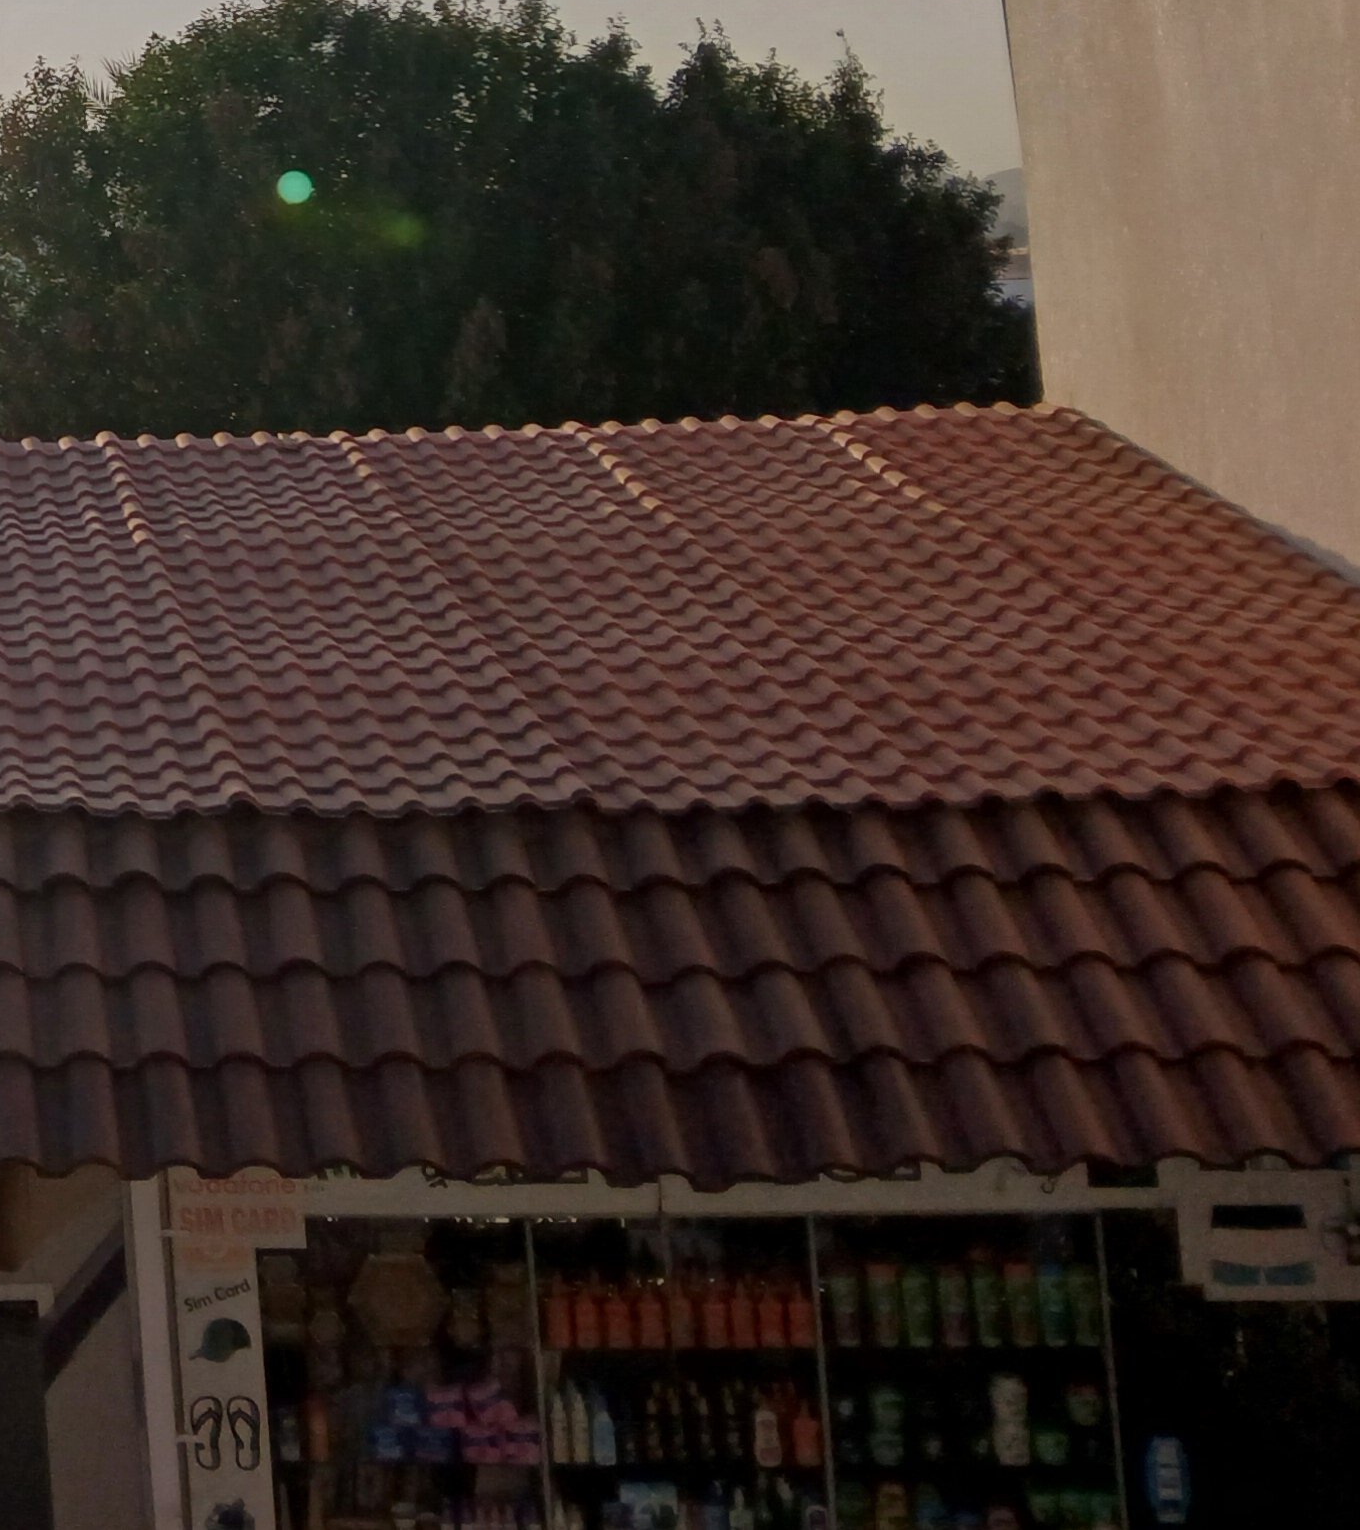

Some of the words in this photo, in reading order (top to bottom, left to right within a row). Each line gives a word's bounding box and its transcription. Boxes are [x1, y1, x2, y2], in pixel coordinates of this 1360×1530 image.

[179, 1206, 225, 1234] SIM
[231, 1206, 297, 1235] CARD
[183, 1291, 214, 1313] Sim
[214, 1278, 252, 1302] Card
